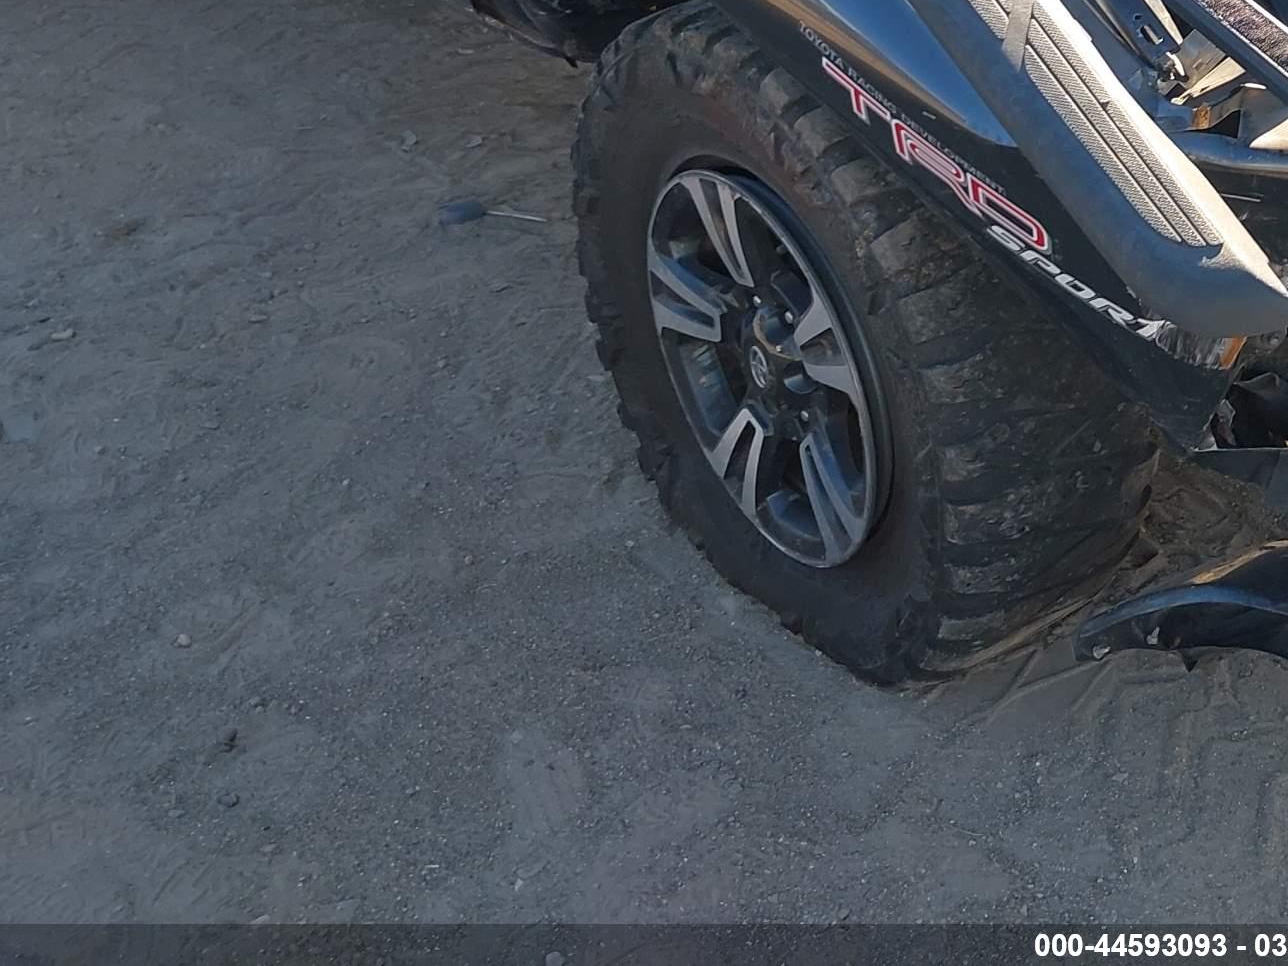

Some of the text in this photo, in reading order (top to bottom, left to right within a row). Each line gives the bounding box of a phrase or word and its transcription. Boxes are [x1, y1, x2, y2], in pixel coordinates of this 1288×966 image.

[799, 20, 1007, 195] TOYOTA RACING DEVELOPMENT
[822, 56, 1051, 254] TRD
